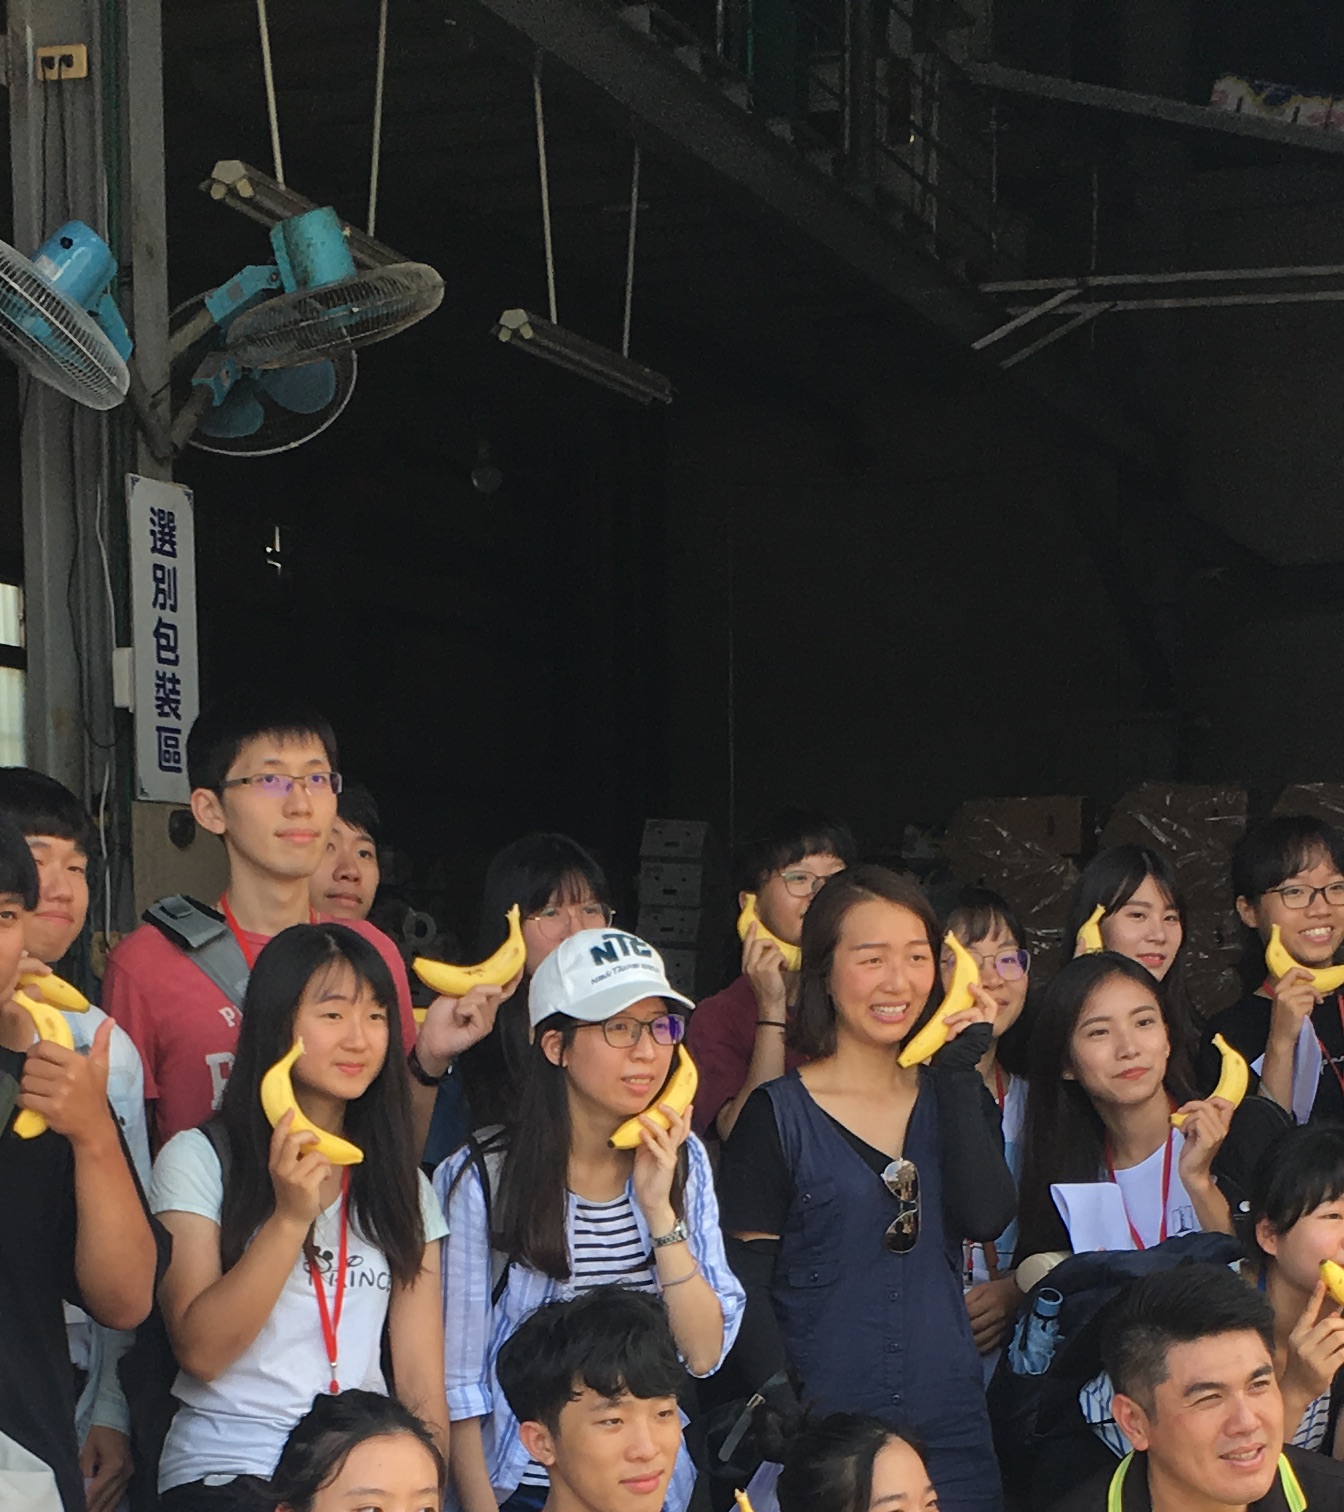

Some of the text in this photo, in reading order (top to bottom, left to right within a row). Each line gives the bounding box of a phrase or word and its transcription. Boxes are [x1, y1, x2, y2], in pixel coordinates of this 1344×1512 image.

[150, 507, 182, 773] 選別包裝區
